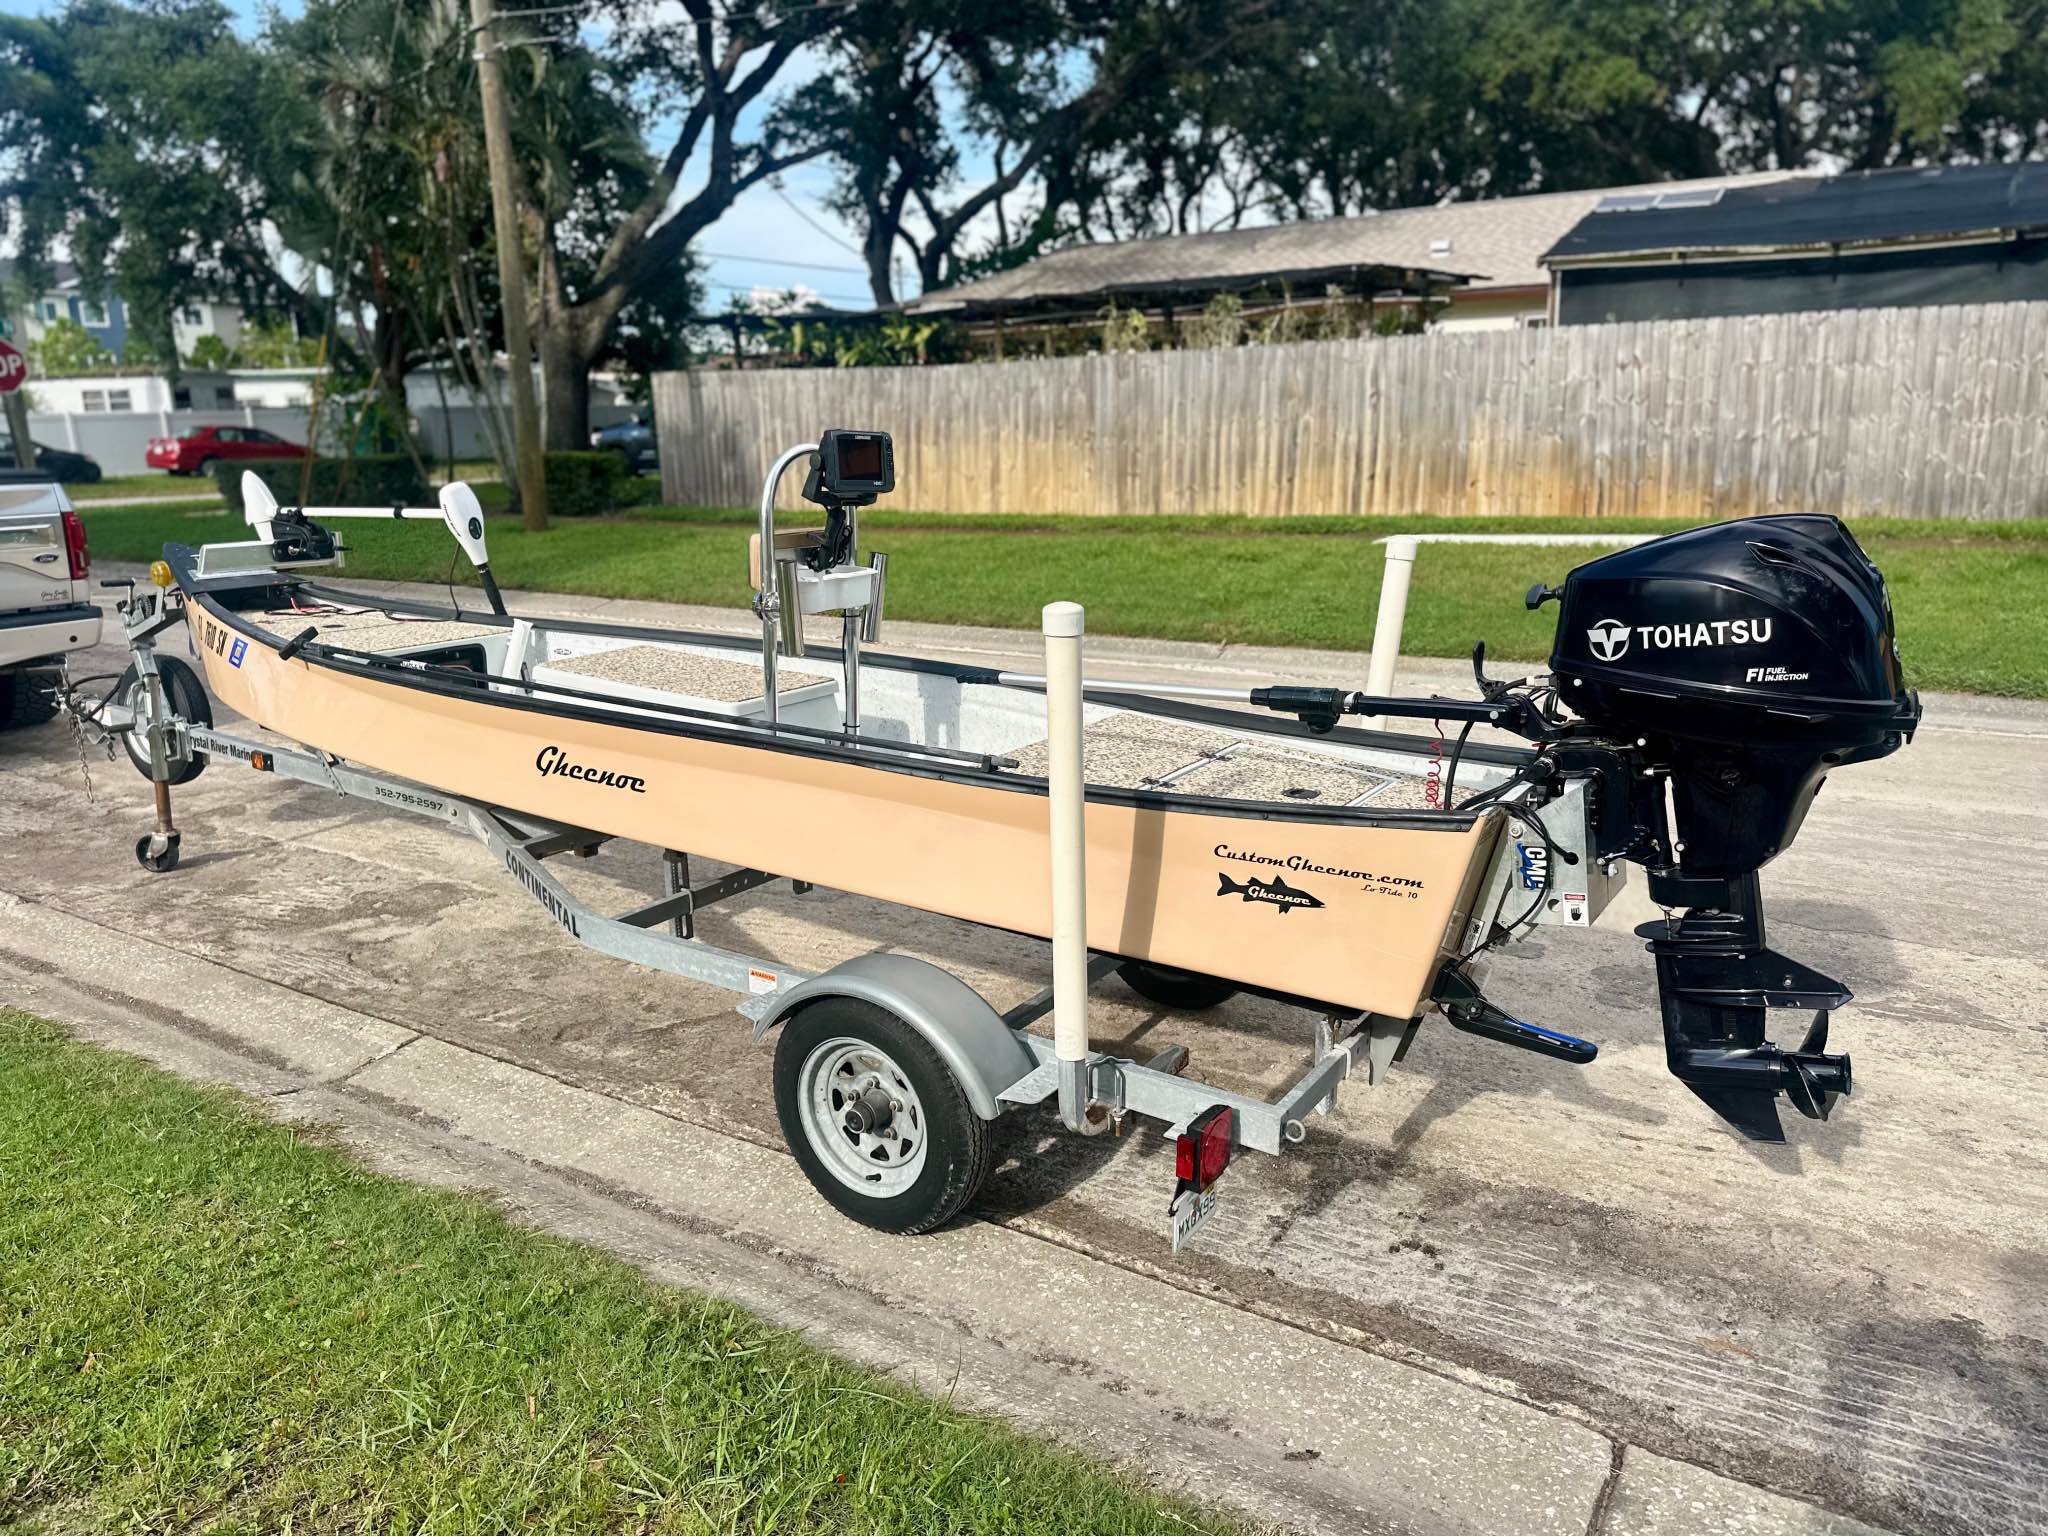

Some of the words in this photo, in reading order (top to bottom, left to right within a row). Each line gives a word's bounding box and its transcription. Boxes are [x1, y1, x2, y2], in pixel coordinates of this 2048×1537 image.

[1637, 618, 1772, 649] TOHATSU
[1765, 672, 1809, 681] INJECTION
[190, 736, 209, 750] rystal
[211, 738, 228, 754] River
[230, 744, 251, 761] Marin
[536, 746, 646, 793] Gheenoe
[375, 786, 443, 811] 352-795-2597
[1214, 844, 1425, 889] CustomGheenoe.com
[506, 848, 580, 938] CONTINENTAL
[1247, 885, 1312, 906] Gheenoe
